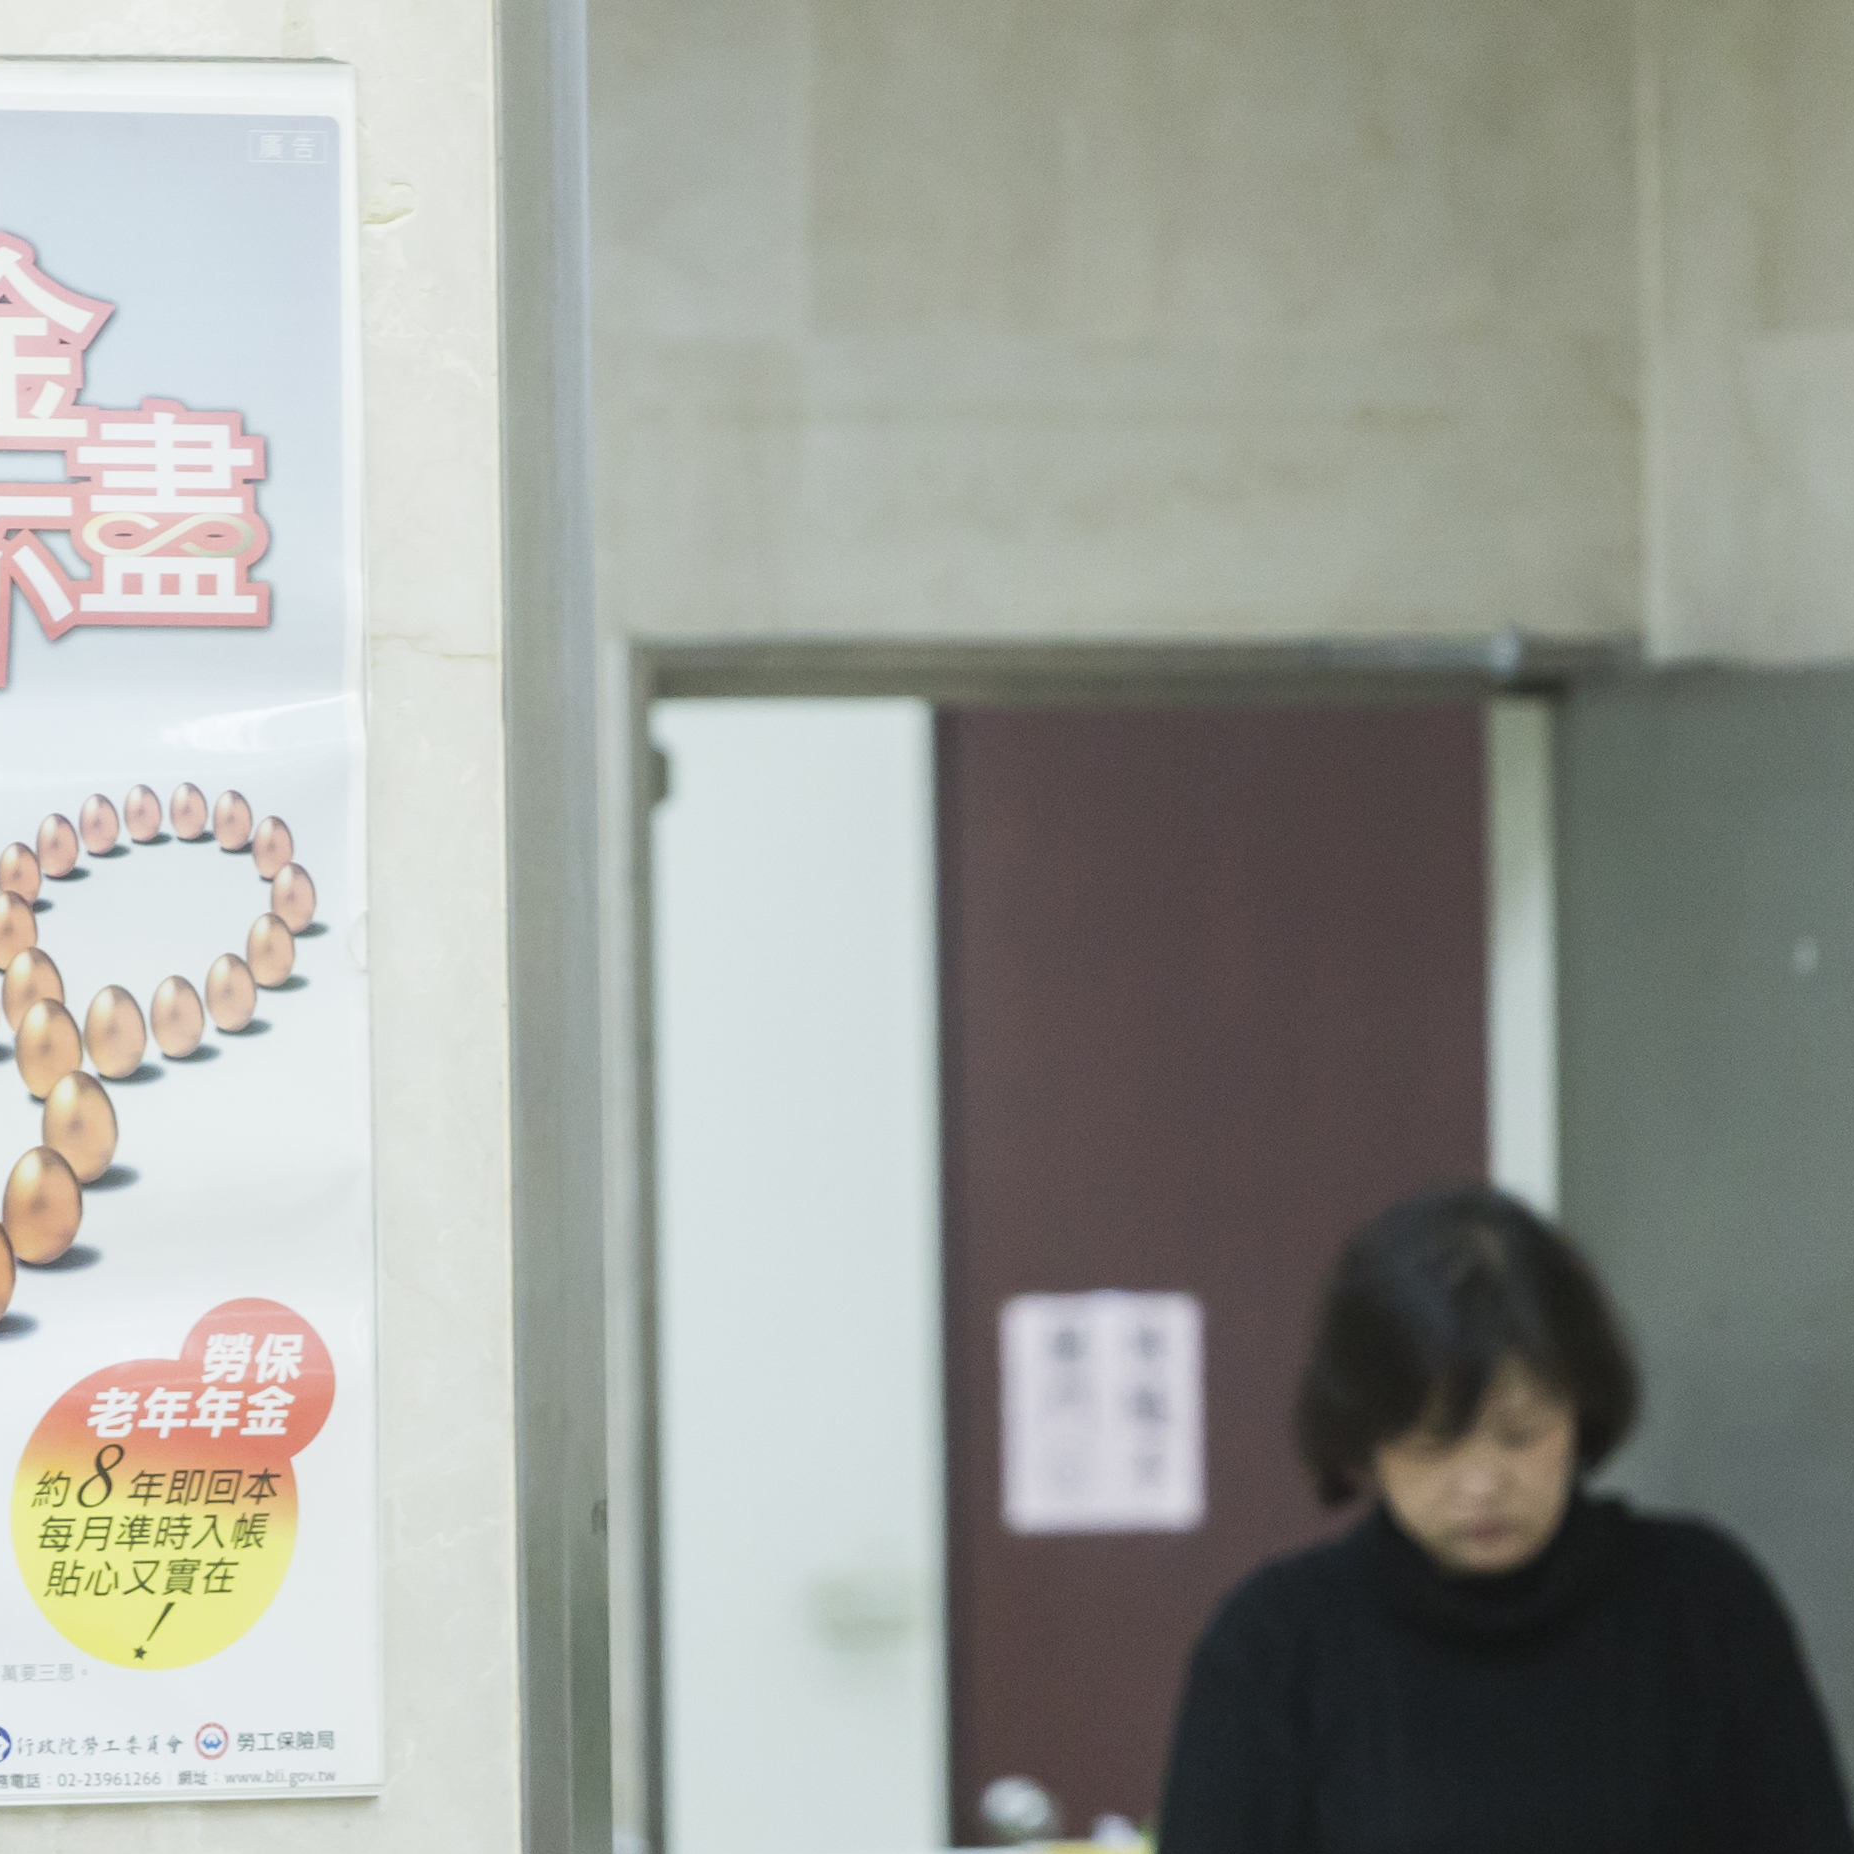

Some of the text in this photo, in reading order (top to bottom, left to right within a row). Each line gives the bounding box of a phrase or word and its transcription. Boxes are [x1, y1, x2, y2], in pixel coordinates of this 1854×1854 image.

[259, 133, 315, 159] 廣告
[201, 1332, 305, 1384] 勞保
[86, 1385, 296, 1439] 老年年金
[31, 1443, 282, 1509] 約8年即回本
[38, 1512, 270, 1554] 每月準時入帳
[43, 1557, 240, 1598] 貼心又實在
[16, 1730, 336, 1757] 行政院勞工委員會 勞工保險局
